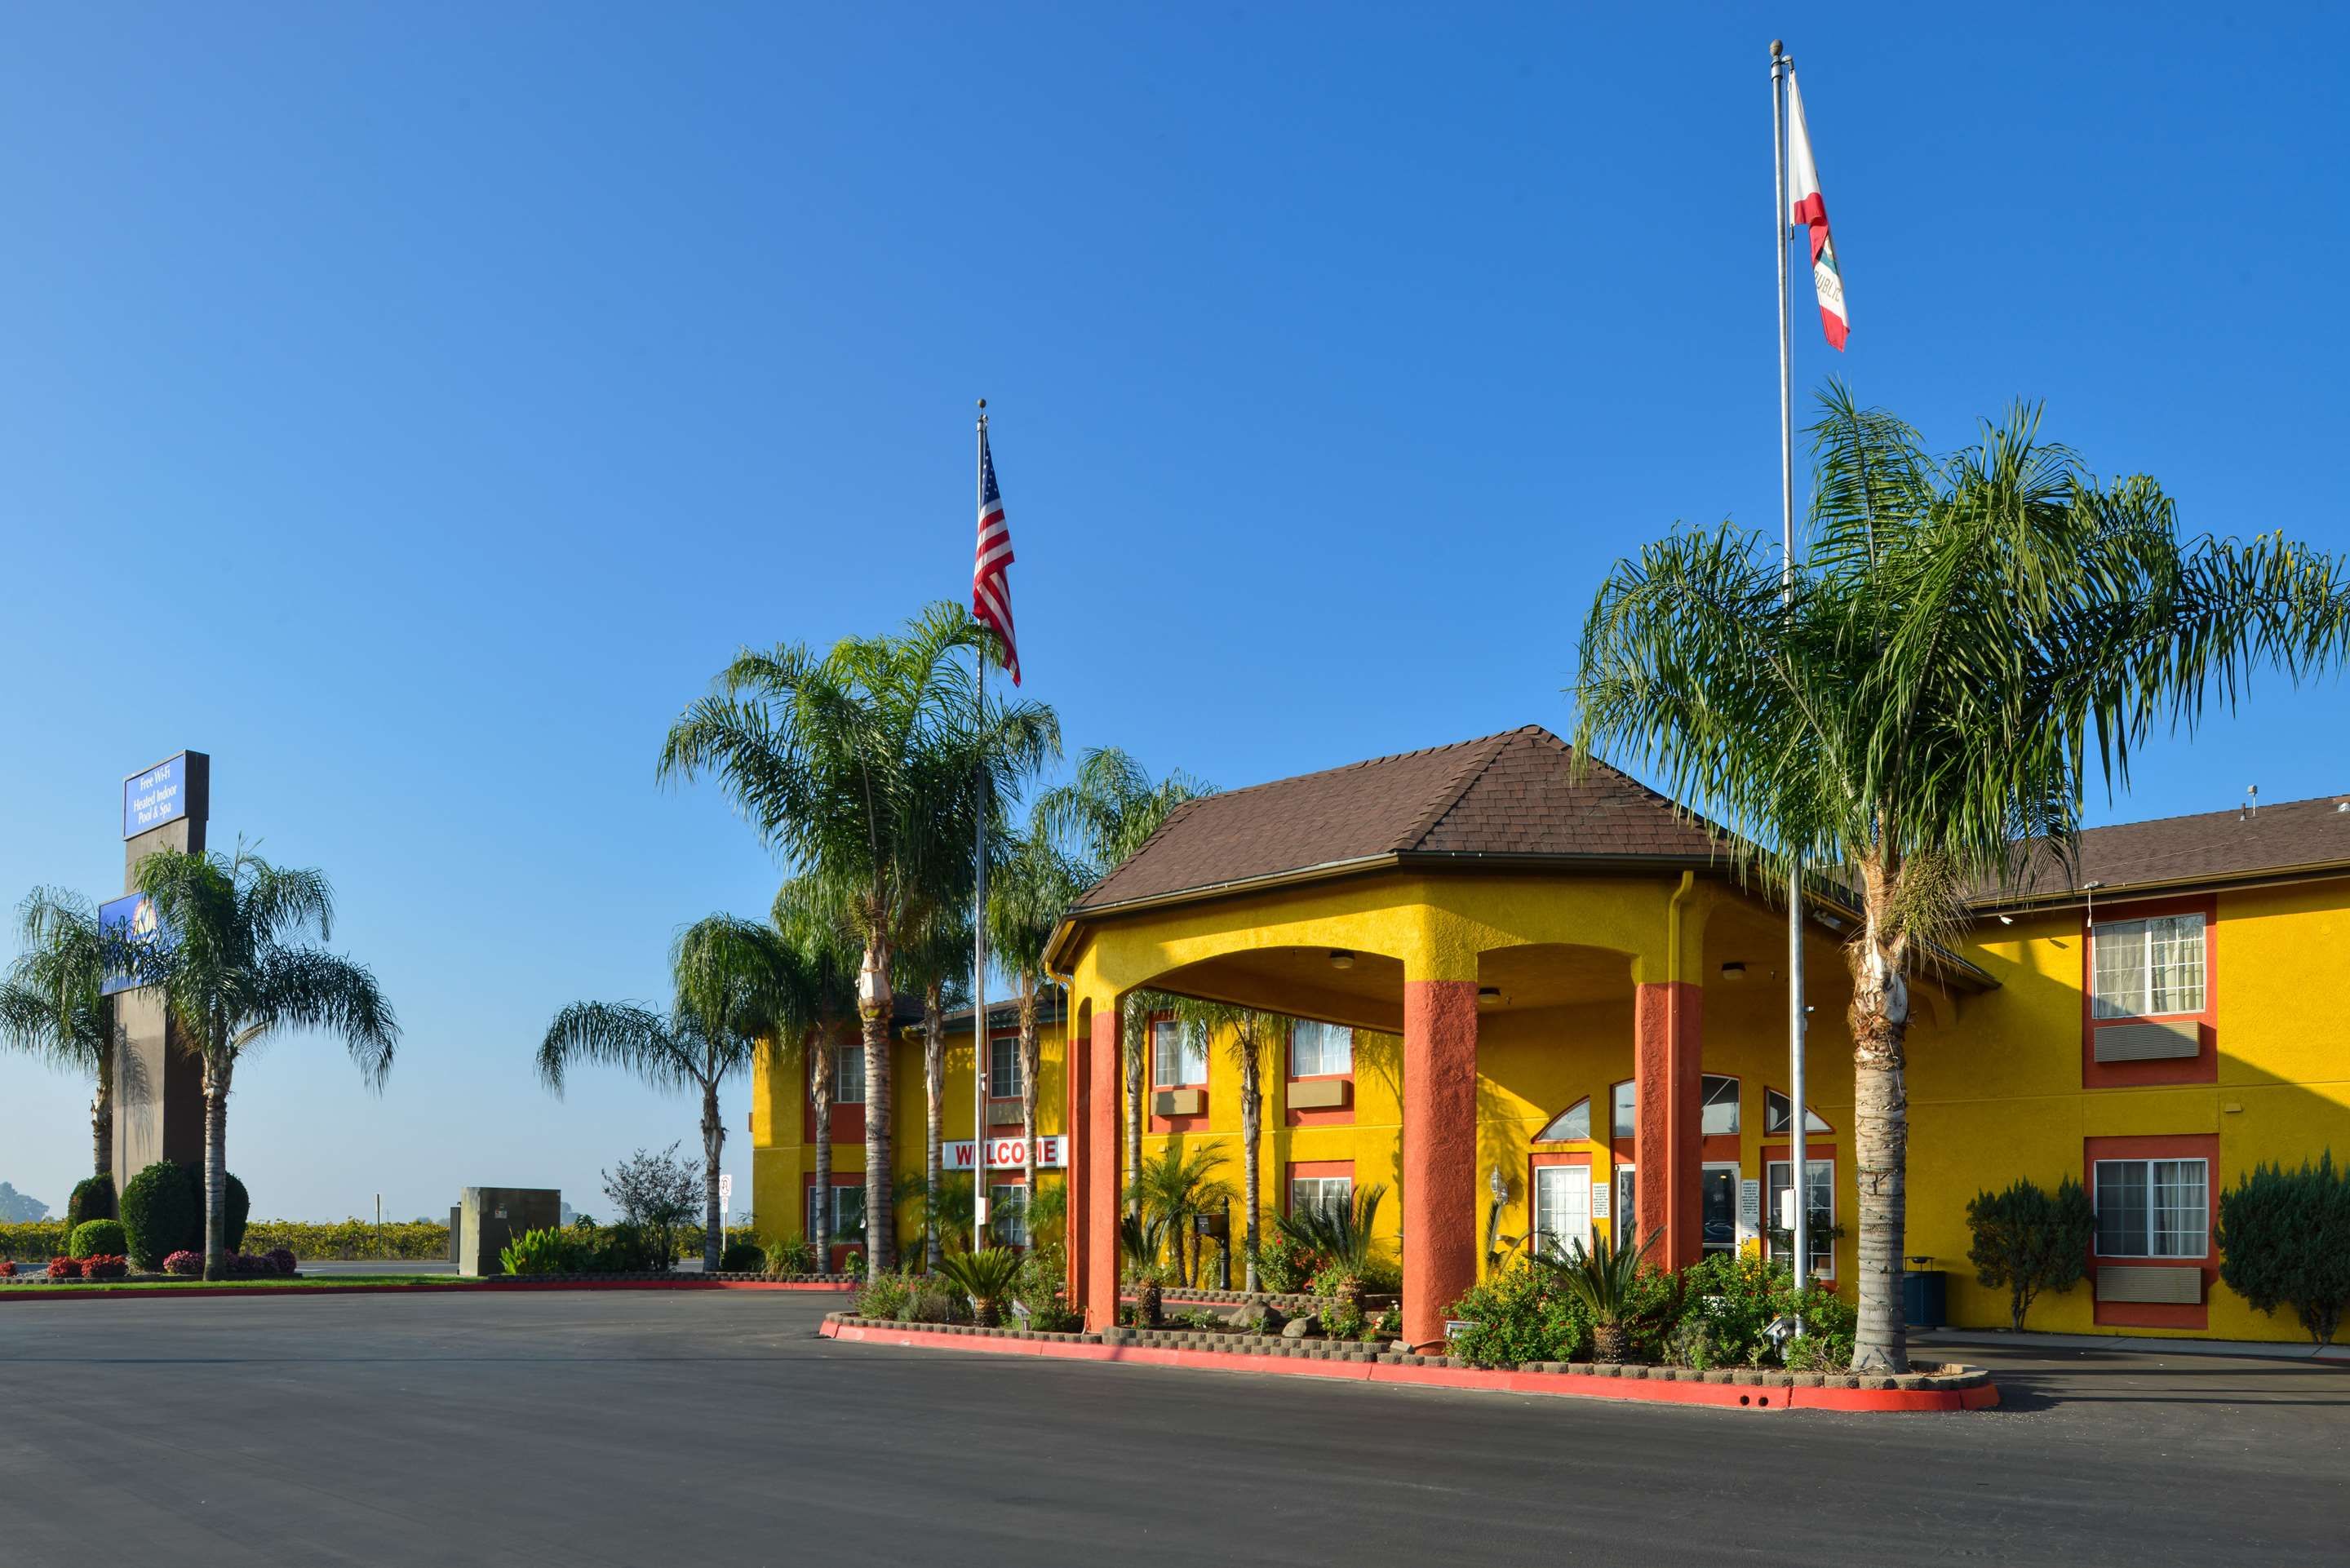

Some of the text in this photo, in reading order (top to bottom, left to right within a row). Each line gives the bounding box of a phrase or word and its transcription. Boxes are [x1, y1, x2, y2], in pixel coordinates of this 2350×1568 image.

[140, 764, 171, 791] Free Wi-Fi
[133, 784, 177, 813] Heated Indoor
[138, 802, 171, 825] Pool & Spa
[956, 1141, 1057, 1166] WLCOE
